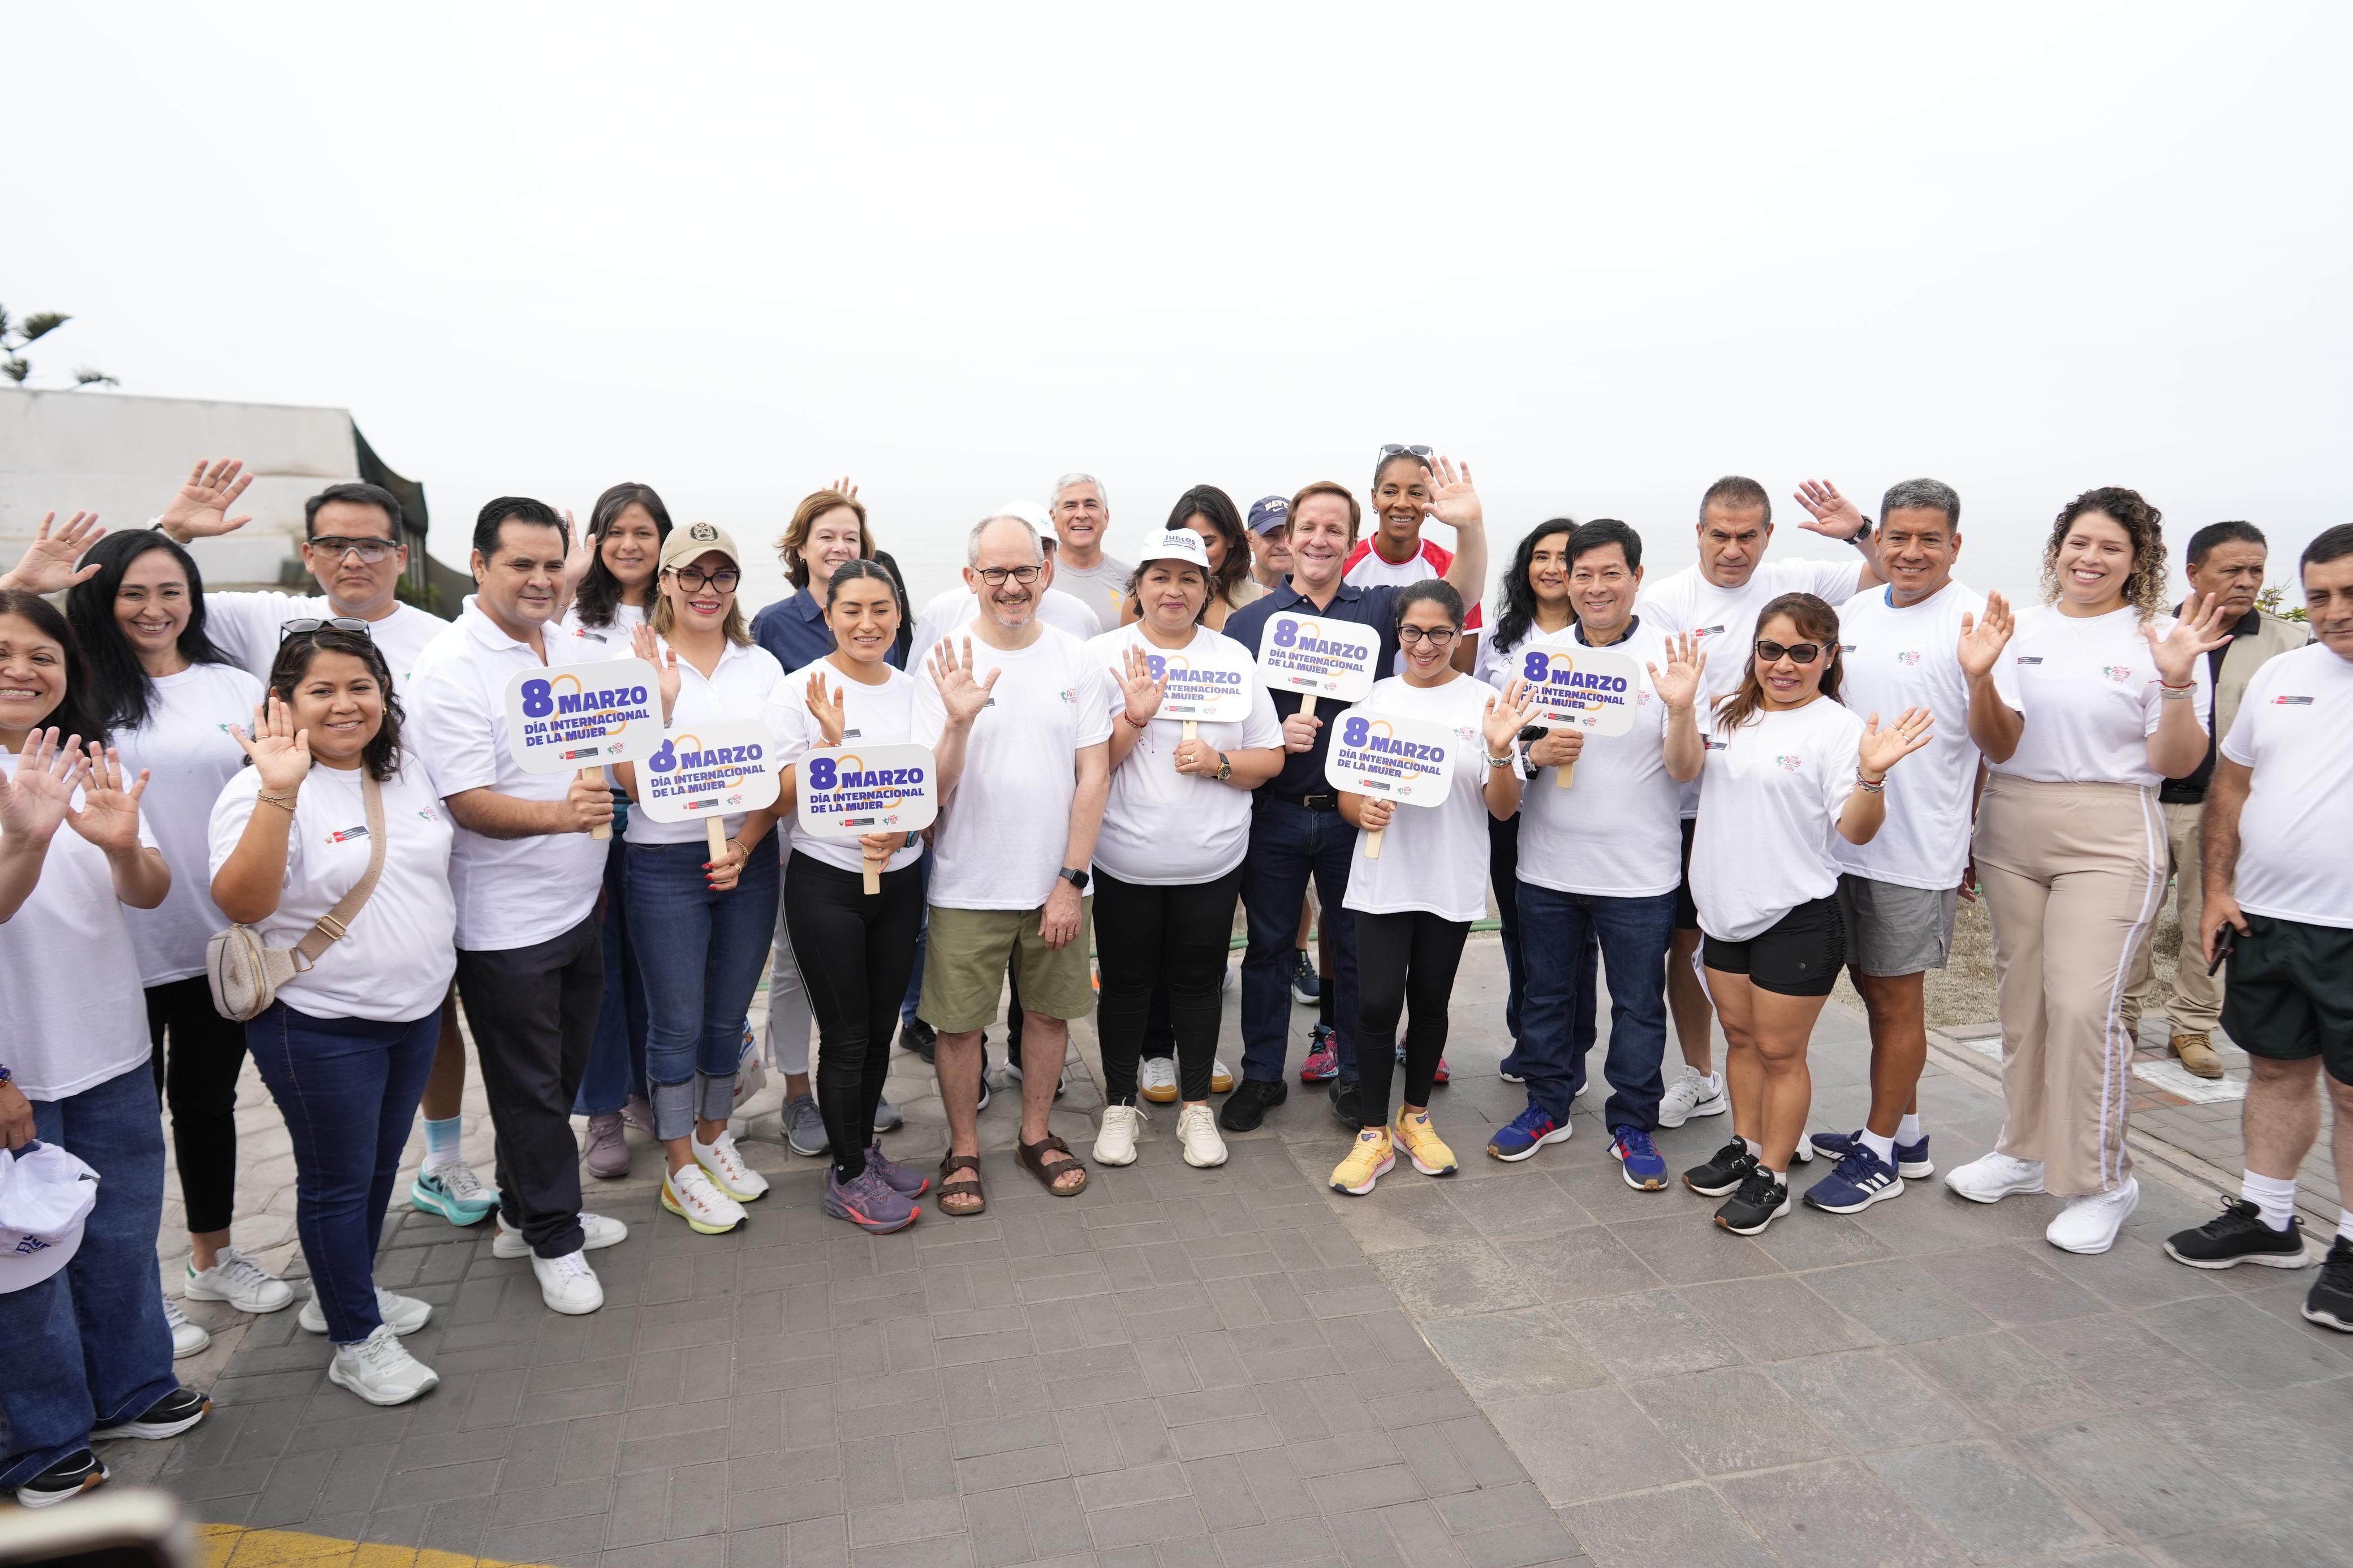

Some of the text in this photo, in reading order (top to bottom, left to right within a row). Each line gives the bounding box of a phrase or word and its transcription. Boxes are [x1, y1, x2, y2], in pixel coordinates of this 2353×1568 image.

[1273, 619, 1368, 660] 8 MARZO
[1147, 655, 1241, 684] 8 MARZO
[1270, 649, 1364, 672] DÍA INTERNACIONAL
[1282, 660, 1294, 669] LA
[1296, 663, 1328, 675] MUJER
[1524, 650, 1627, 693] 8 MARZO
[521, 679, 648, 718] 8 MARZO
[1165, 684, 1241, 695] NTERNACIONAL
[1171, 692, 1204, 701] MUJER
[1541, 687, 1624, 705] INTERNACIONAL
[1536, 696, 1549, 705] LA
[1551, 698, 1585, 709] MUJER
[524, 709, 649, 735] DÍA INTERNACIONAL
[525, 727, 606, 746] DE LA MUJER
[1343, 716, 1445, 763] 8 MARZO
[649, 739, 676, 772] 8
[680, 744, 762, 769] MARZO
[1339, 749, 1441, 775] DÍA INTERNACIONAL
[650, 764, 765, 787] DÍA INTERNACIONAL
[809, 758, 924, 790] 8 MARZO
[1337, 759, 1402, 777] DE LA MUJER
[652, 780, 726, 798] DE LA MUJER
[810, 788, 924, 804] DÍA INTERNACIONAL
[811, 801, 883, 813] DE LA MUJER
